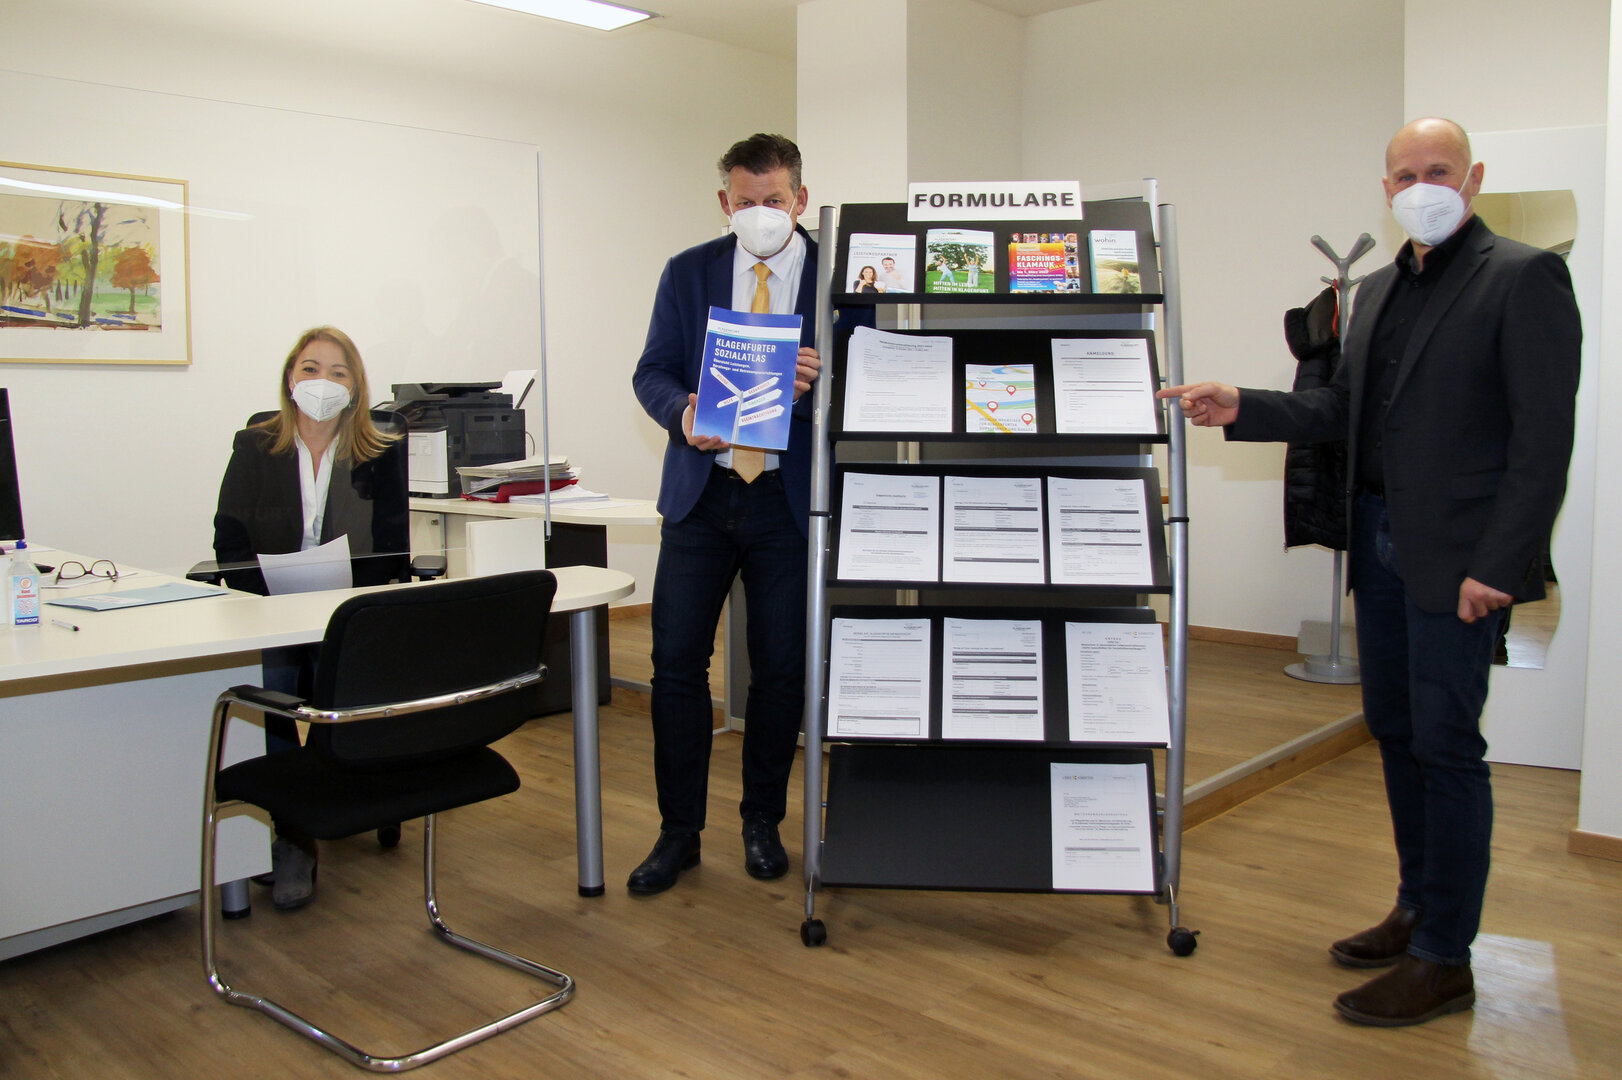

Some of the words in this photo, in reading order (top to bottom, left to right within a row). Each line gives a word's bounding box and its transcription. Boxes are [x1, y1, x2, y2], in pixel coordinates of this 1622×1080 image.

[914, 193, 1074, 208] FORMULARE
[716, 338, 776, 353] KLAGENFURTER
[714, 348, 766, 363] SOZIALATLAS
